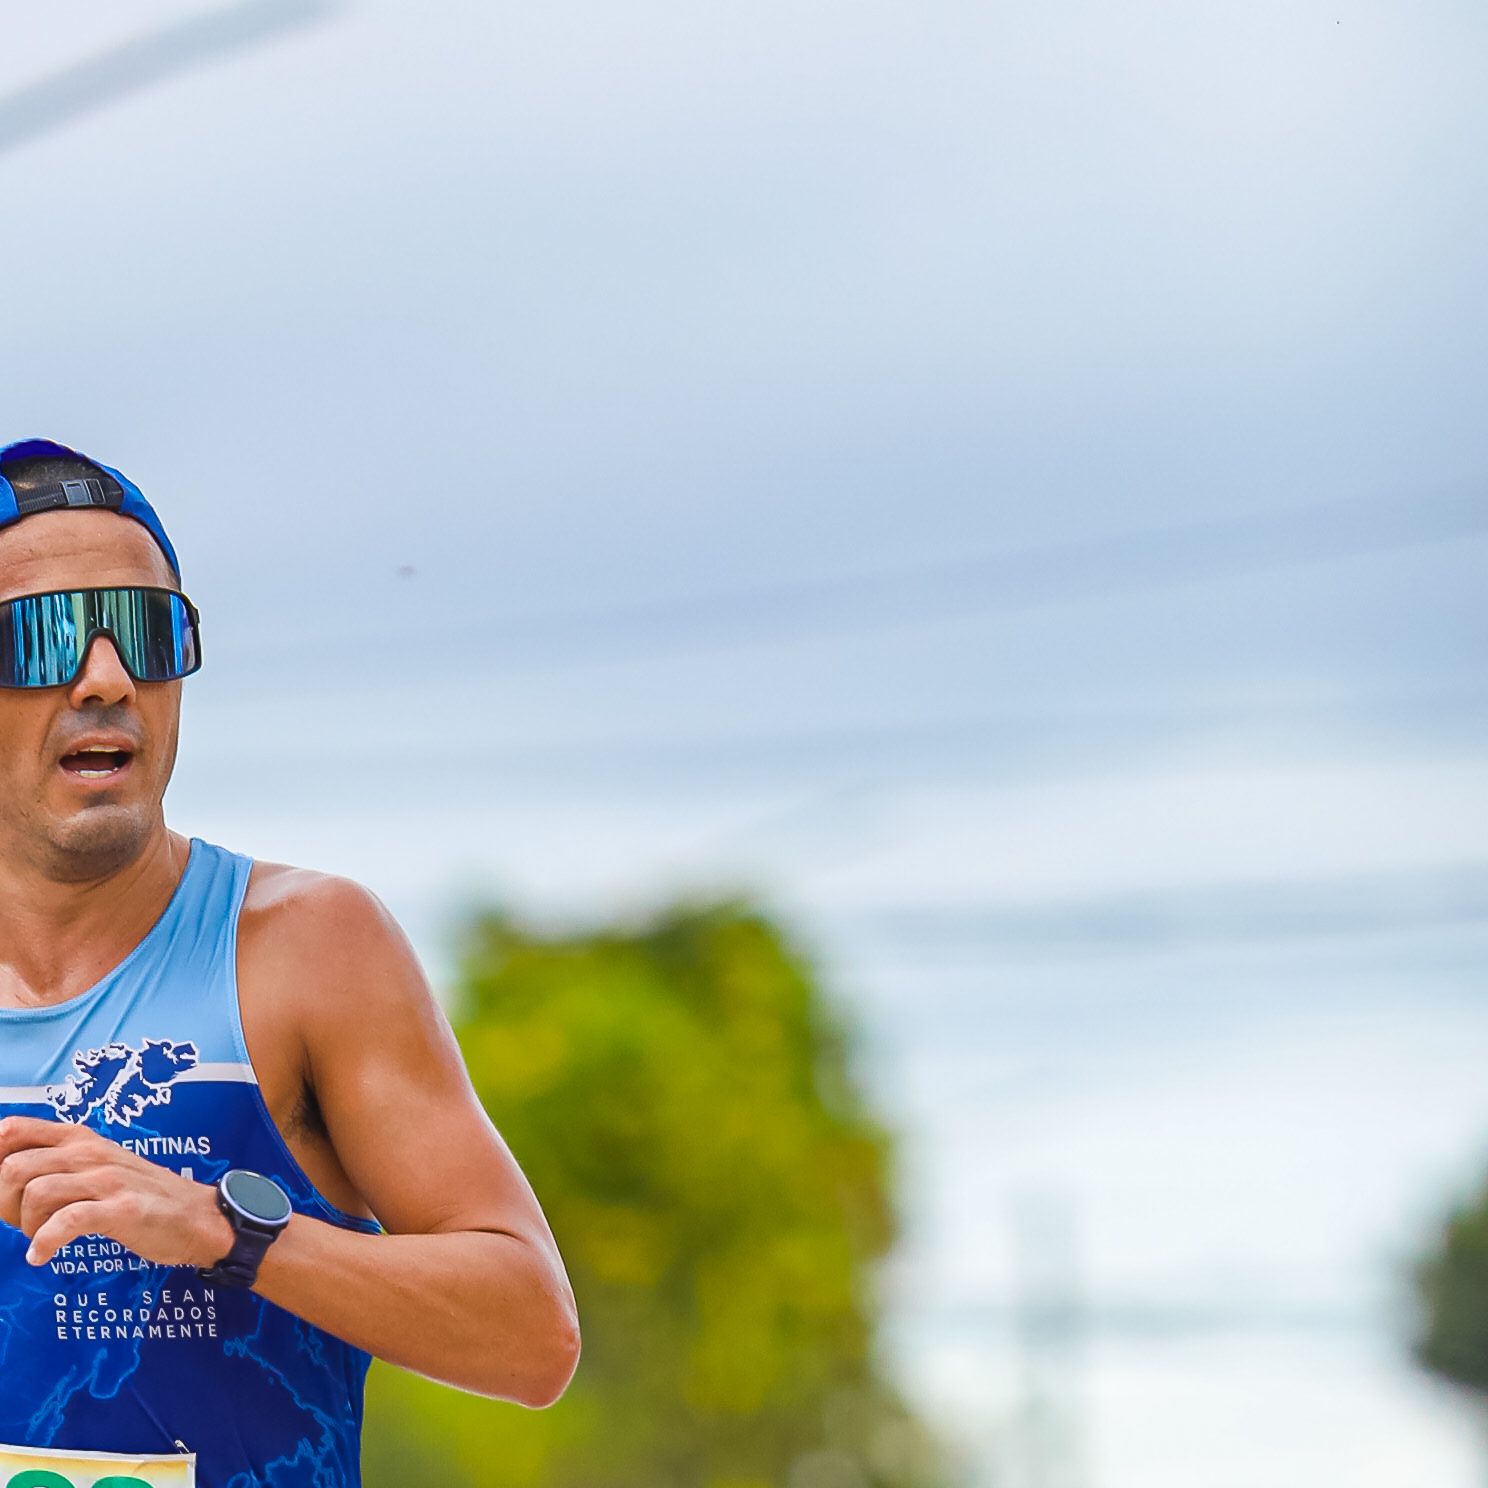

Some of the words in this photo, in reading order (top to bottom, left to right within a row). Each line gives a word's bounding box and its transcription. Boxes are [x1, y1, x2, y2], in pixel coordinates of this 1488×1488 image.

[50, 1261, 92, 1275] VIDA
[94, 1259, 124, 1274] POR
[128, 1257, 149, 1271] LA
[53, 1292, 108, 1307] QUE
[142, 1289, 215, 1305] SEAN
[55, 1306, 217, 1323] RECORDADOS
[57, 1323, 218, 1340] ETERNAMENTE
